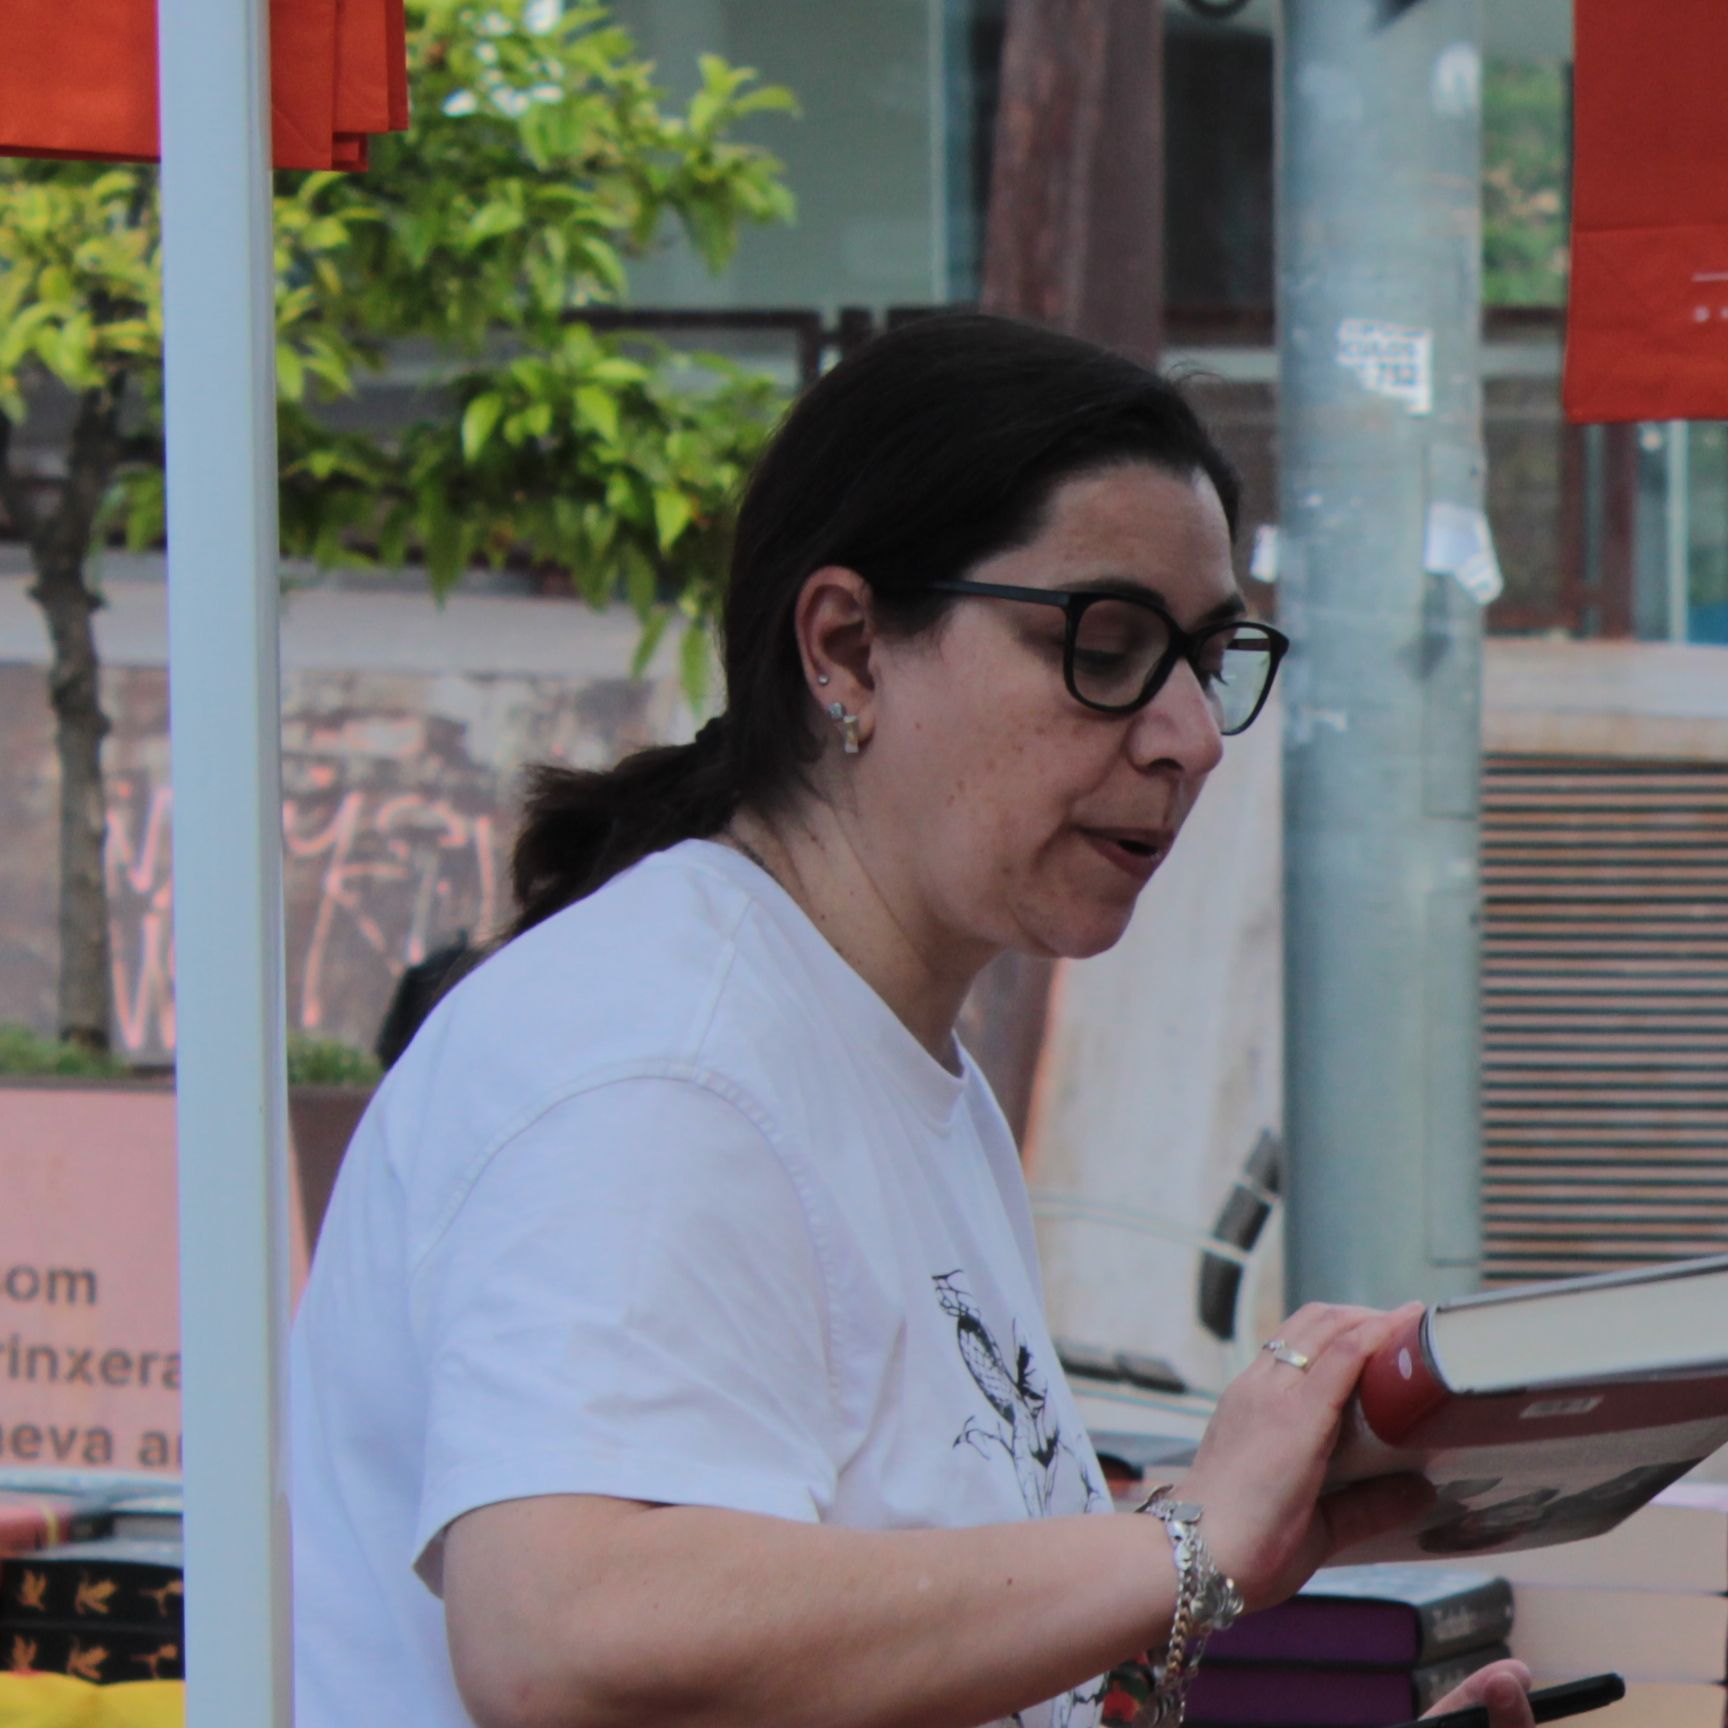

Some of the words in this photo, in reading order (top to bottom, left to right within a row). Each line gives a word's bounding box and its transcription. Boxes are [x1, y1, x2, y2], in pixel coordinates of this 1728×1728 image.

[0, 1265, 97, 1305] om
[0, 1333, 181, 1390] inxera
[0, 1422, 113, 1464] eva
[139, 1430, 182, 1472] a
